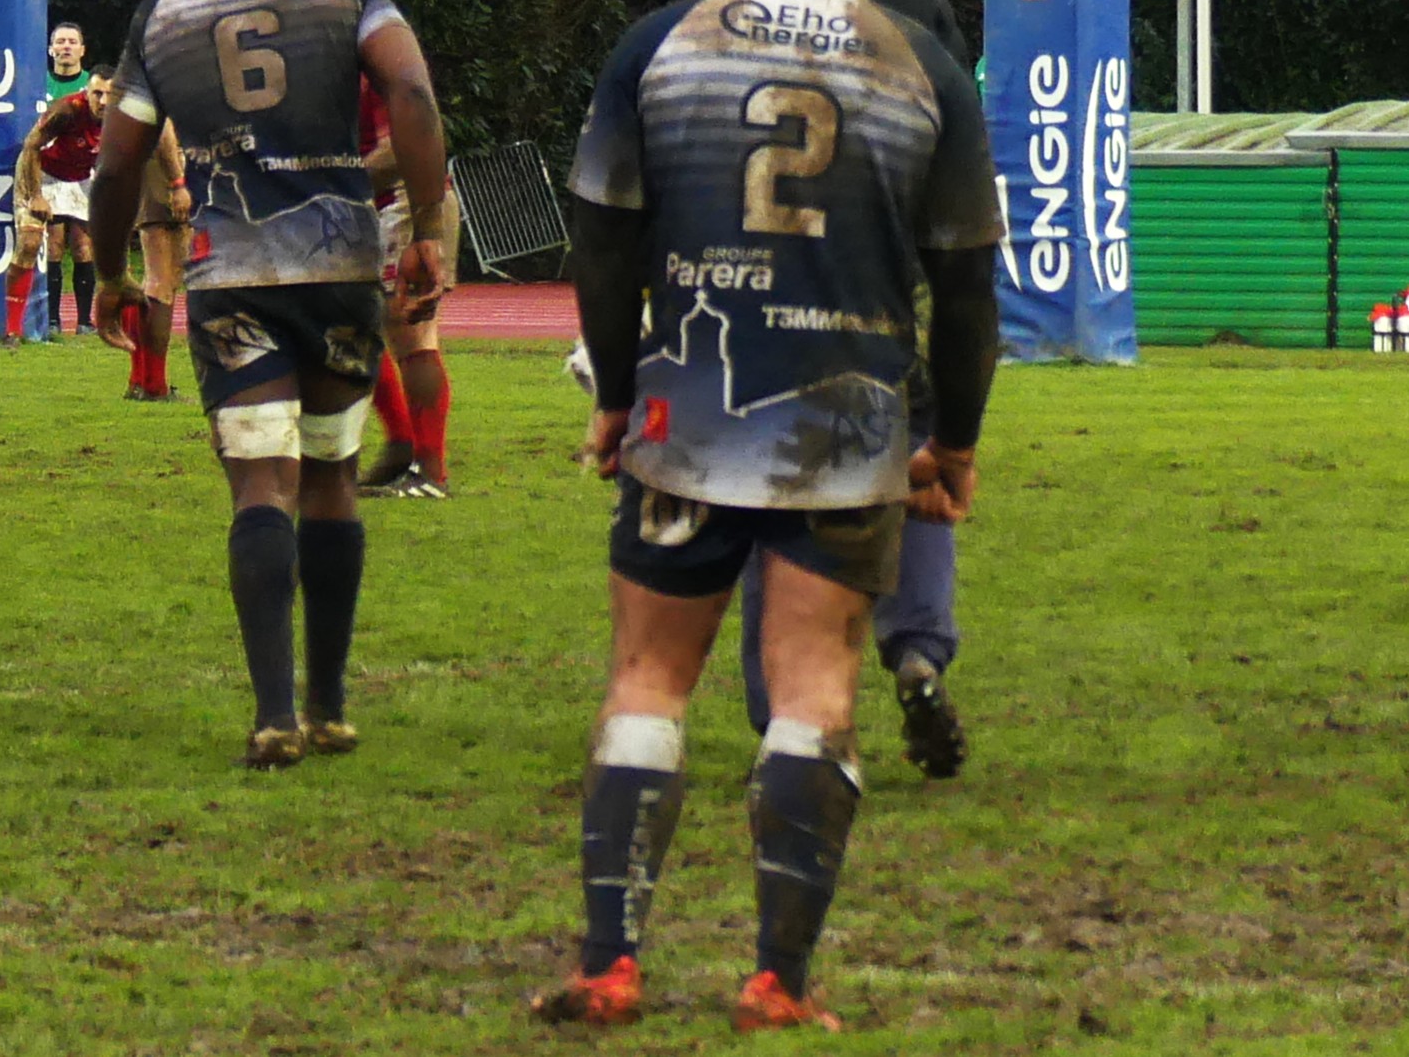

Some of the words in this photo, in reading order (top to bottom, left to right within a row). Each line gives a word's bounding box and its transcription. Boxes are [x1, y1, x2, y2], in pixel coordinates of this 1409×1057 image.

[778, 5, 852, 33] Eho
[214, 9, 286, 112] 6
[741, 81, 842, 238] 2
[667, 252, 774, 290] Parera
